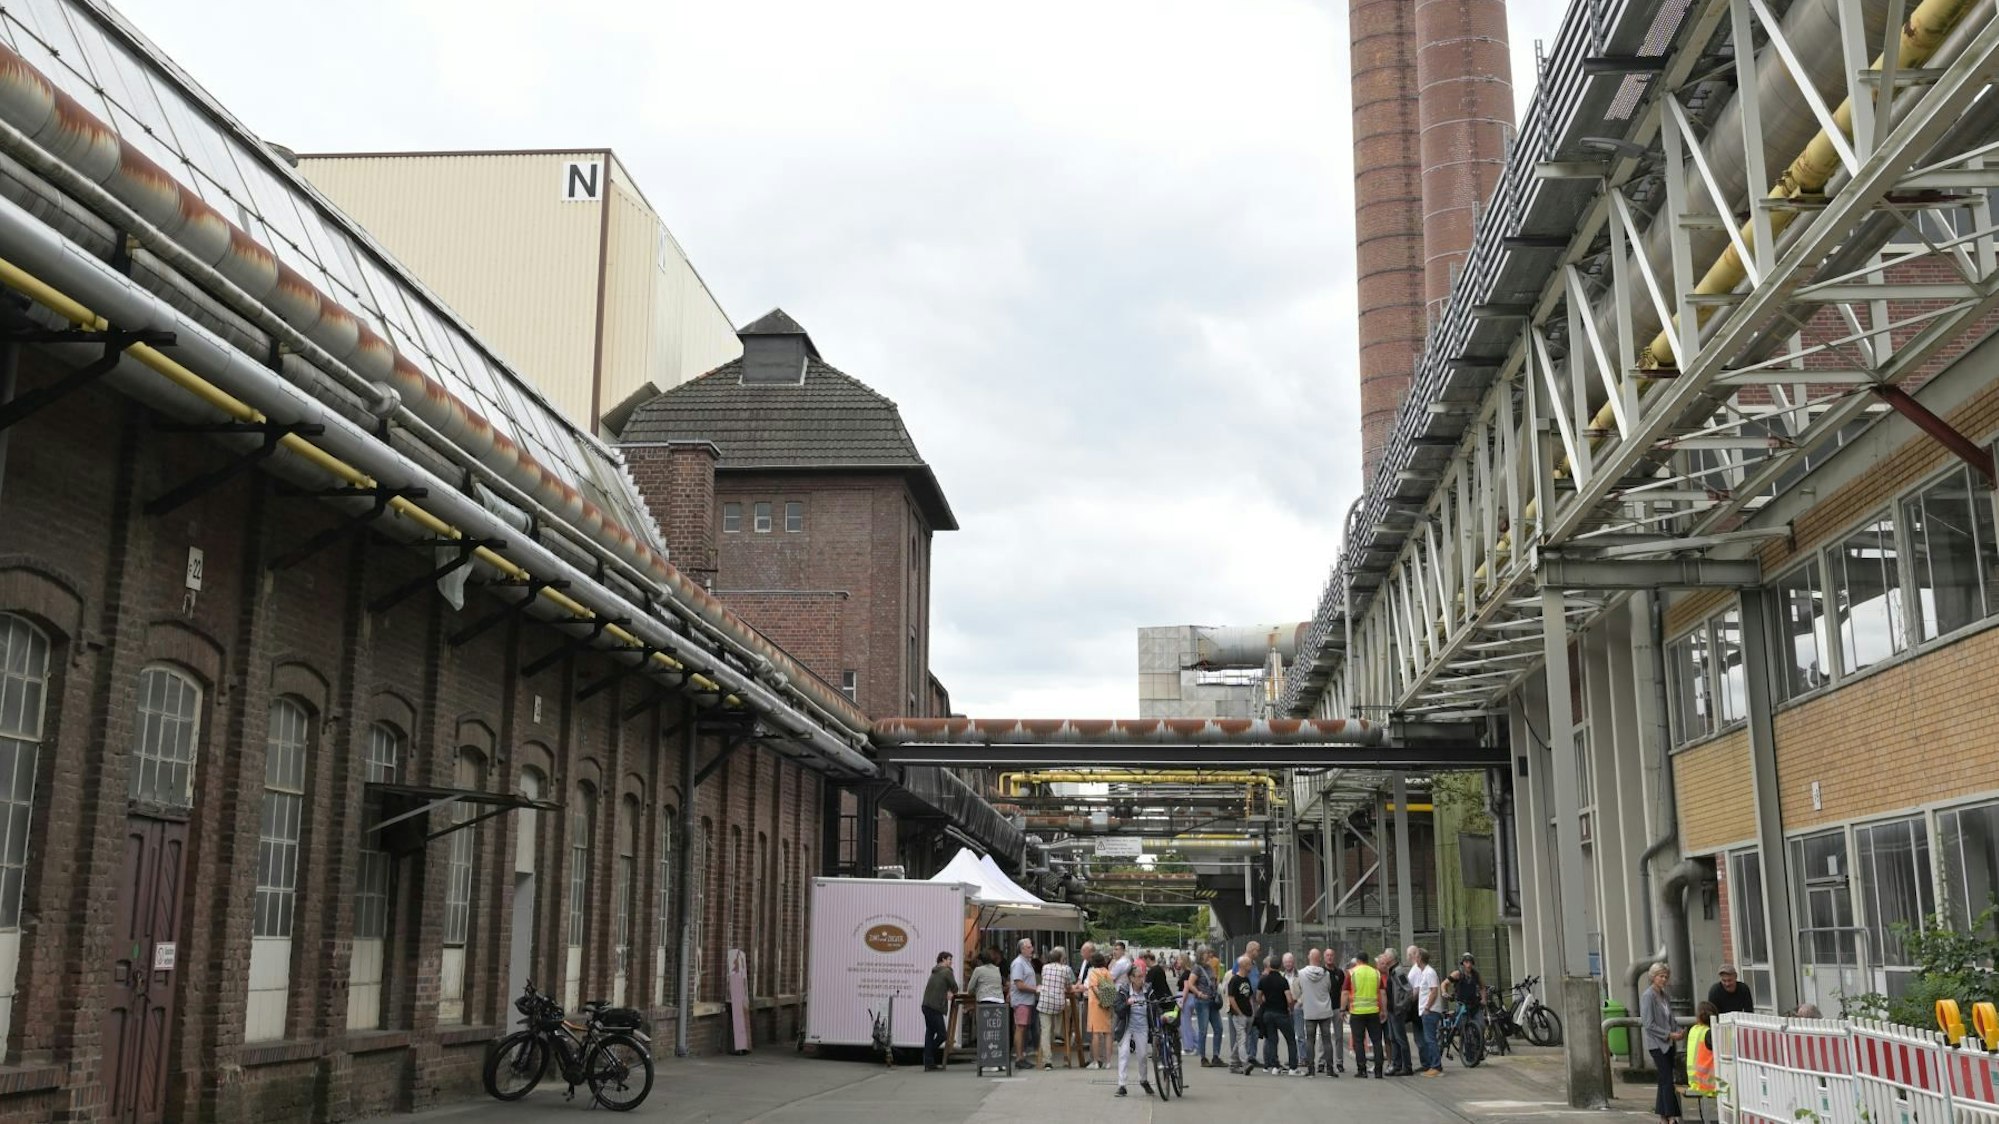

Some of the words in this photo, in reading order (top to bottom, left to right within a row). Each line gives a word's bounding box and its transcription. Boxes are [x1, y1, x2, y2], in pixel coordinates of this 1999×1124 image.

[568, 164, 598, 198] N
[986, 1018, 1002, 1028] ICED
[983, 1030, 1001, 1041] COFFEE
